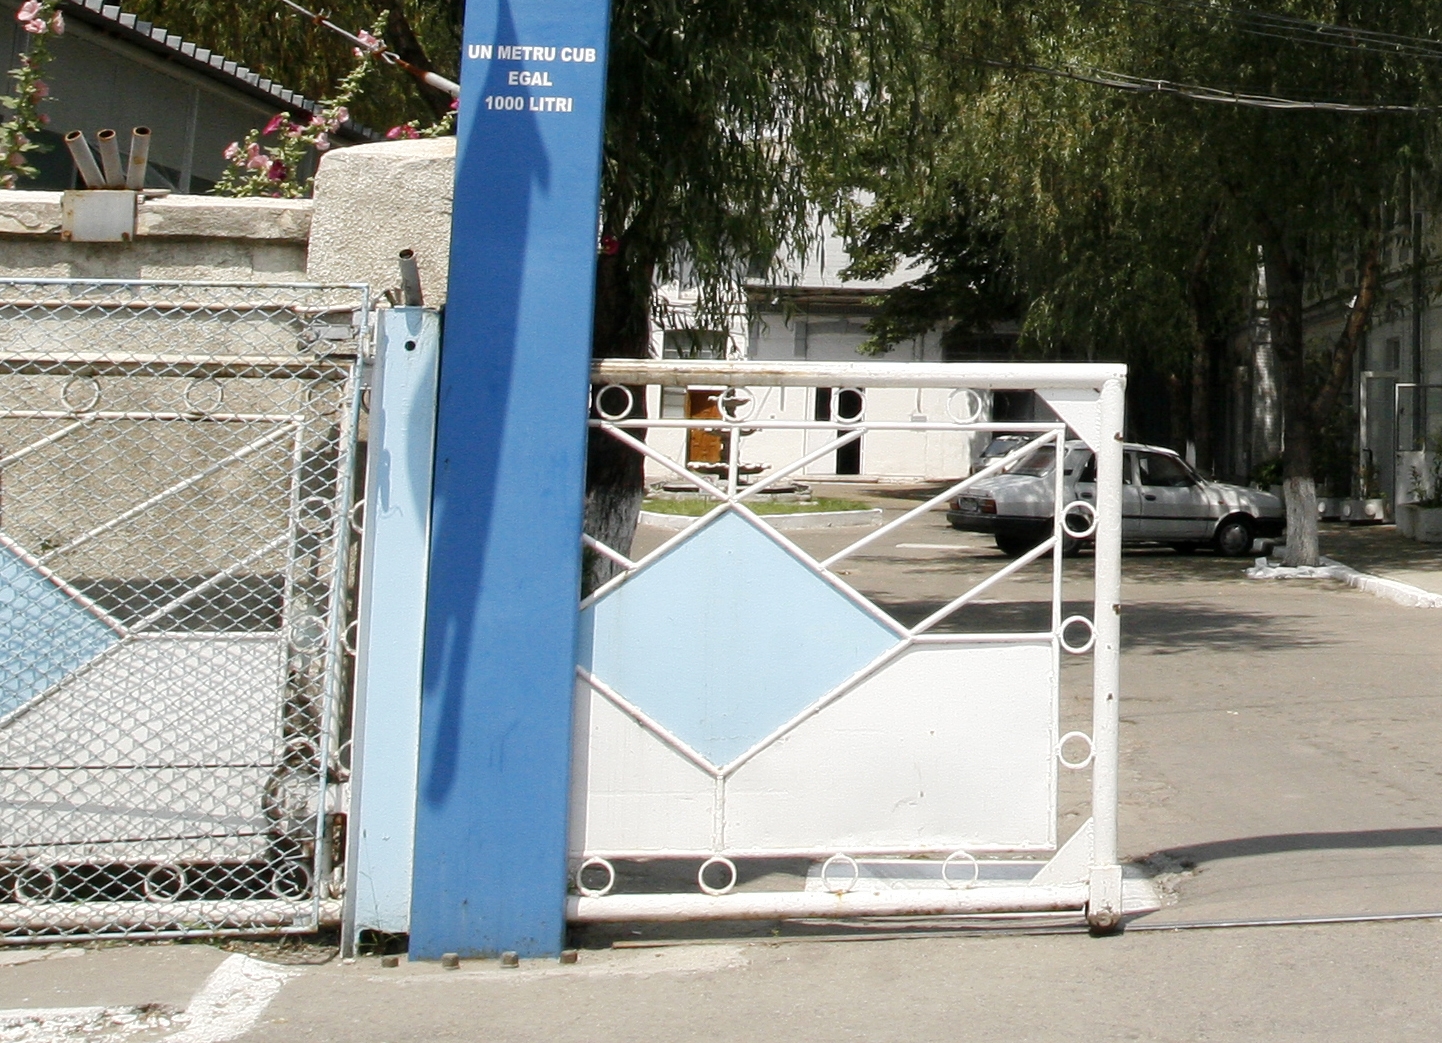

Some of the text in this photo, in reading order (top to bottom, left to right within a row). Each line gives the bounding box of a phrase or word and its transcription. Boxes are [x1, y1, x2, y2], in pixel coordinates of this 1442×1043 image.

[468, 44, 596, 63] UN METRU CUB
[508, 71, 553, 86] EGAL
[485, 96, 573, 113] 1000 LITRI
